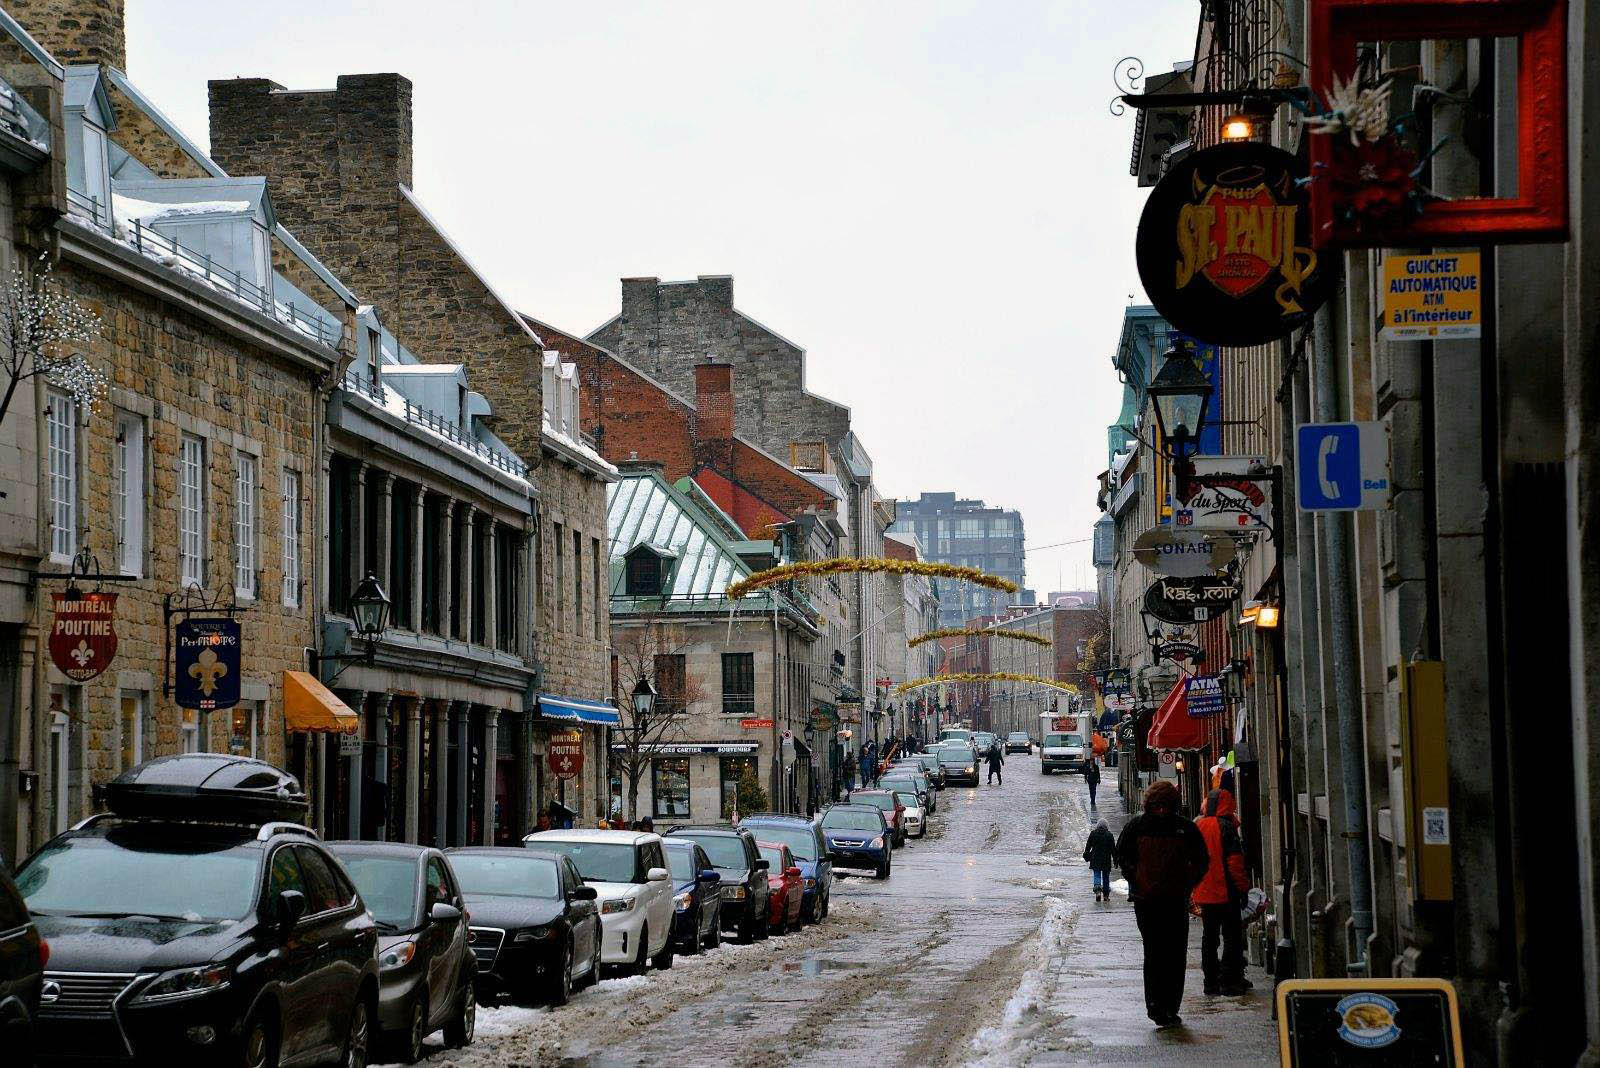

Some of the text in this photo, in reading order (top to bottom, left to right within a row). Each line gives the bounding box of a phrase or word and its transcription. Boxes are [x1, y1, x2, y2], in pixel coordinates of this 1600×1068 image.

[1224, 204, 1298, 297] PAUL
[1406, 258, 1458, 274] GUICHET
[1390, 276, 1477, 293] AUTOMATIQUE
[1423, 293, 1445, 306] ATM
[1363, 479, 1387, 490] Bell
[1192, 493, 1250, 513] du Sport
[56, 620, 111, 636] POUTINE
[1189, 677, 1219, 690] ATM
[551, 745, 580, 755] POUTINE
